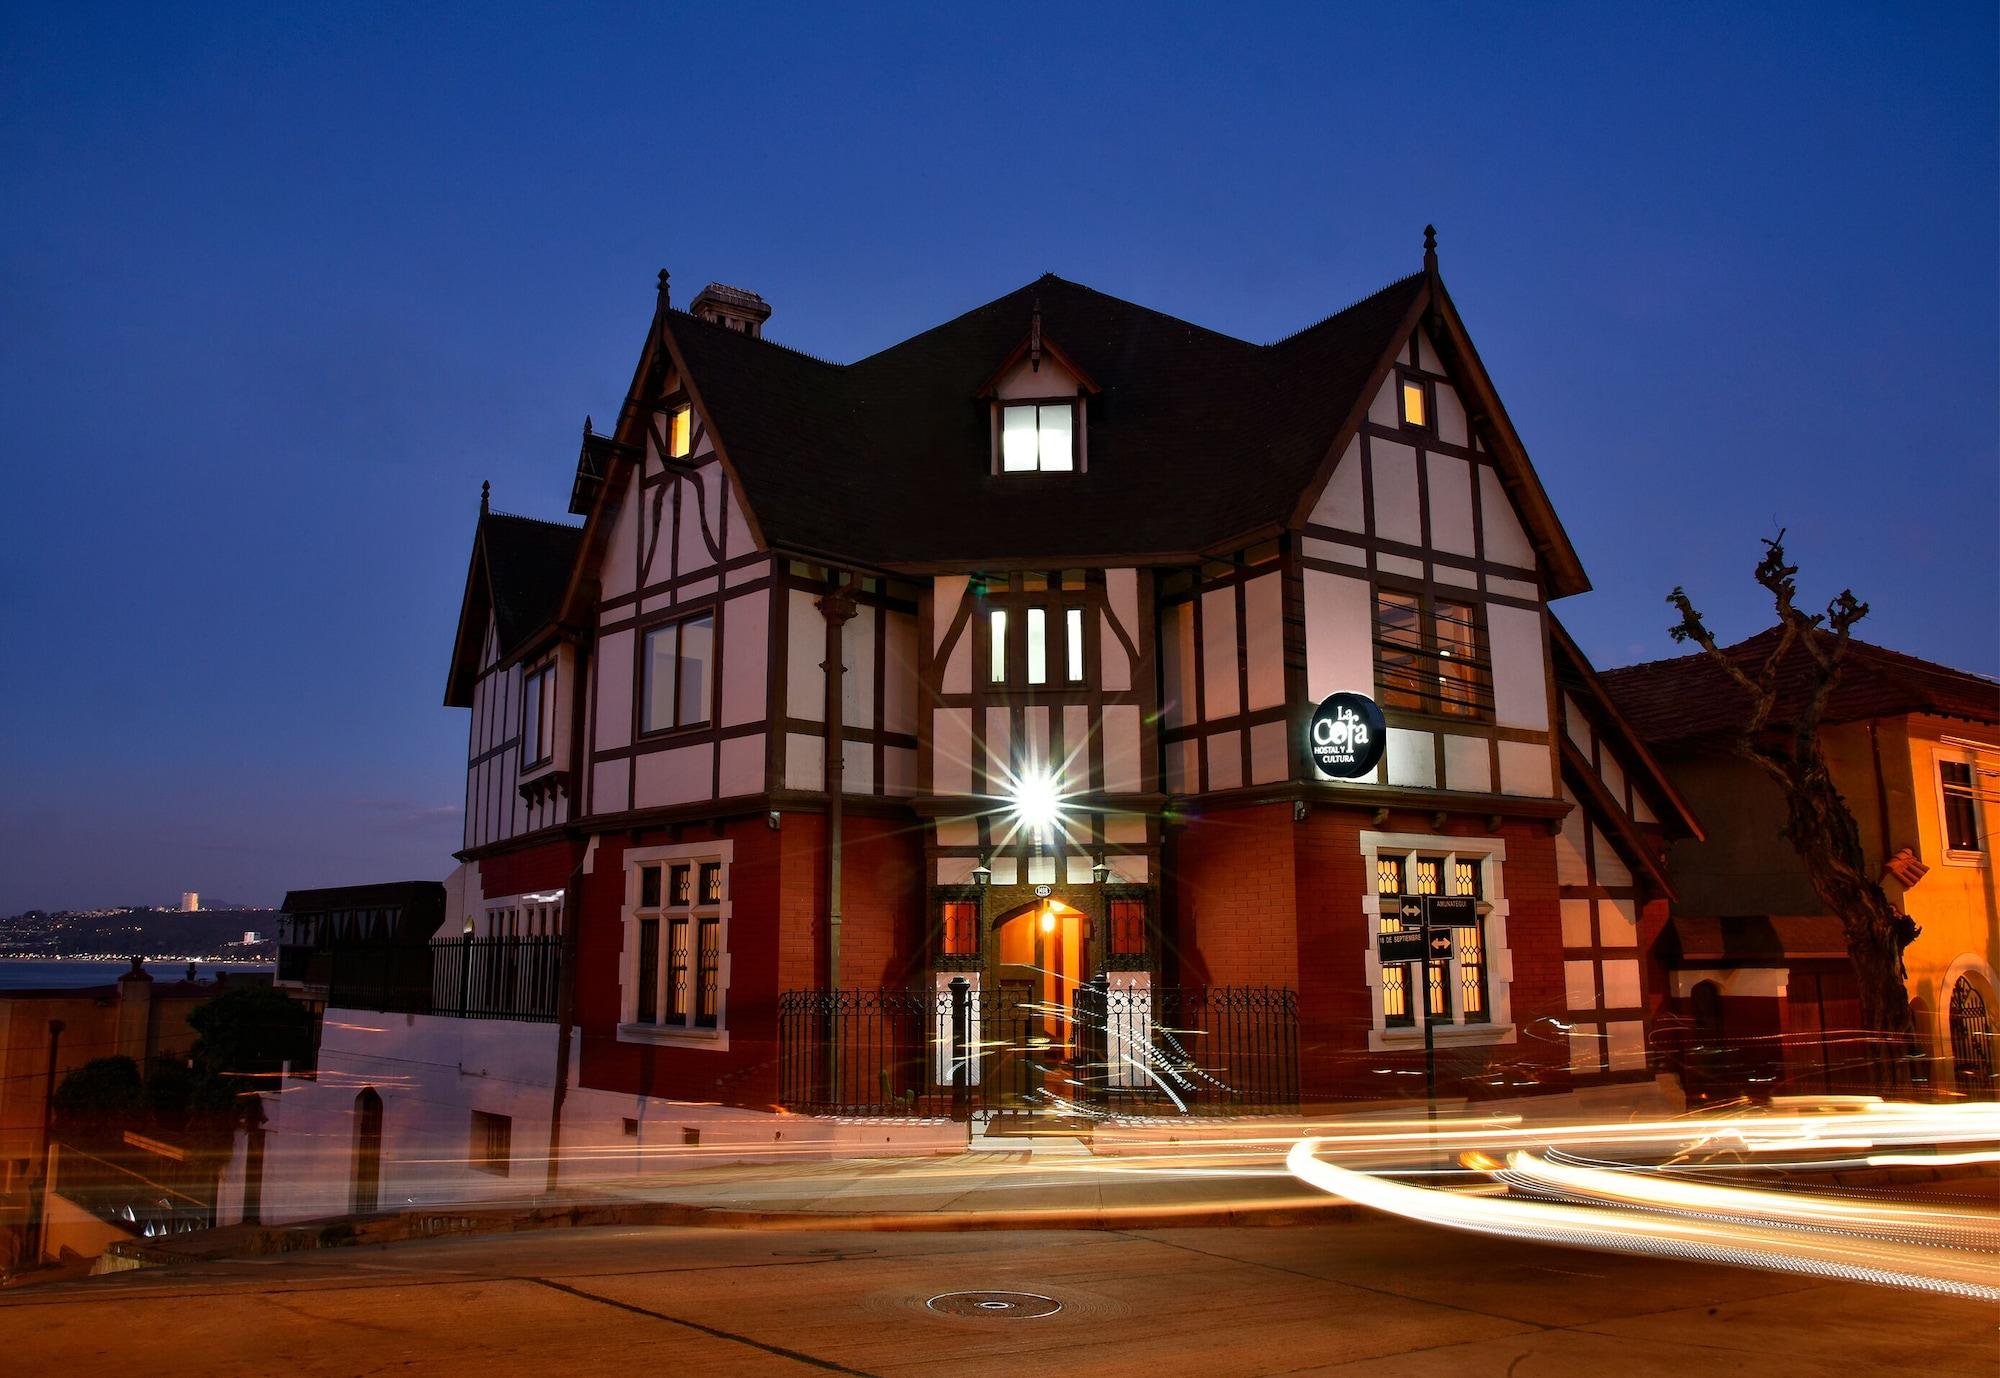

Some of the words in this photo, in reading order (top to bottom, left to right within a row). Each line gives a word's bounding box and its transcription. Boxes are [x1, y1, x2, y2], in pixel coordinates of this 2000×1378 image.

[1337, 706, 1352, 720] La
[1314, 715, 1369, 753] Cofa
[1314, 746, 1339, 754] HOSTAL
[1340, 746, 1345, 754] Y
[1322, 755, 1354, 763] CULTURA
[1386, 935, 1393, 944] DE
